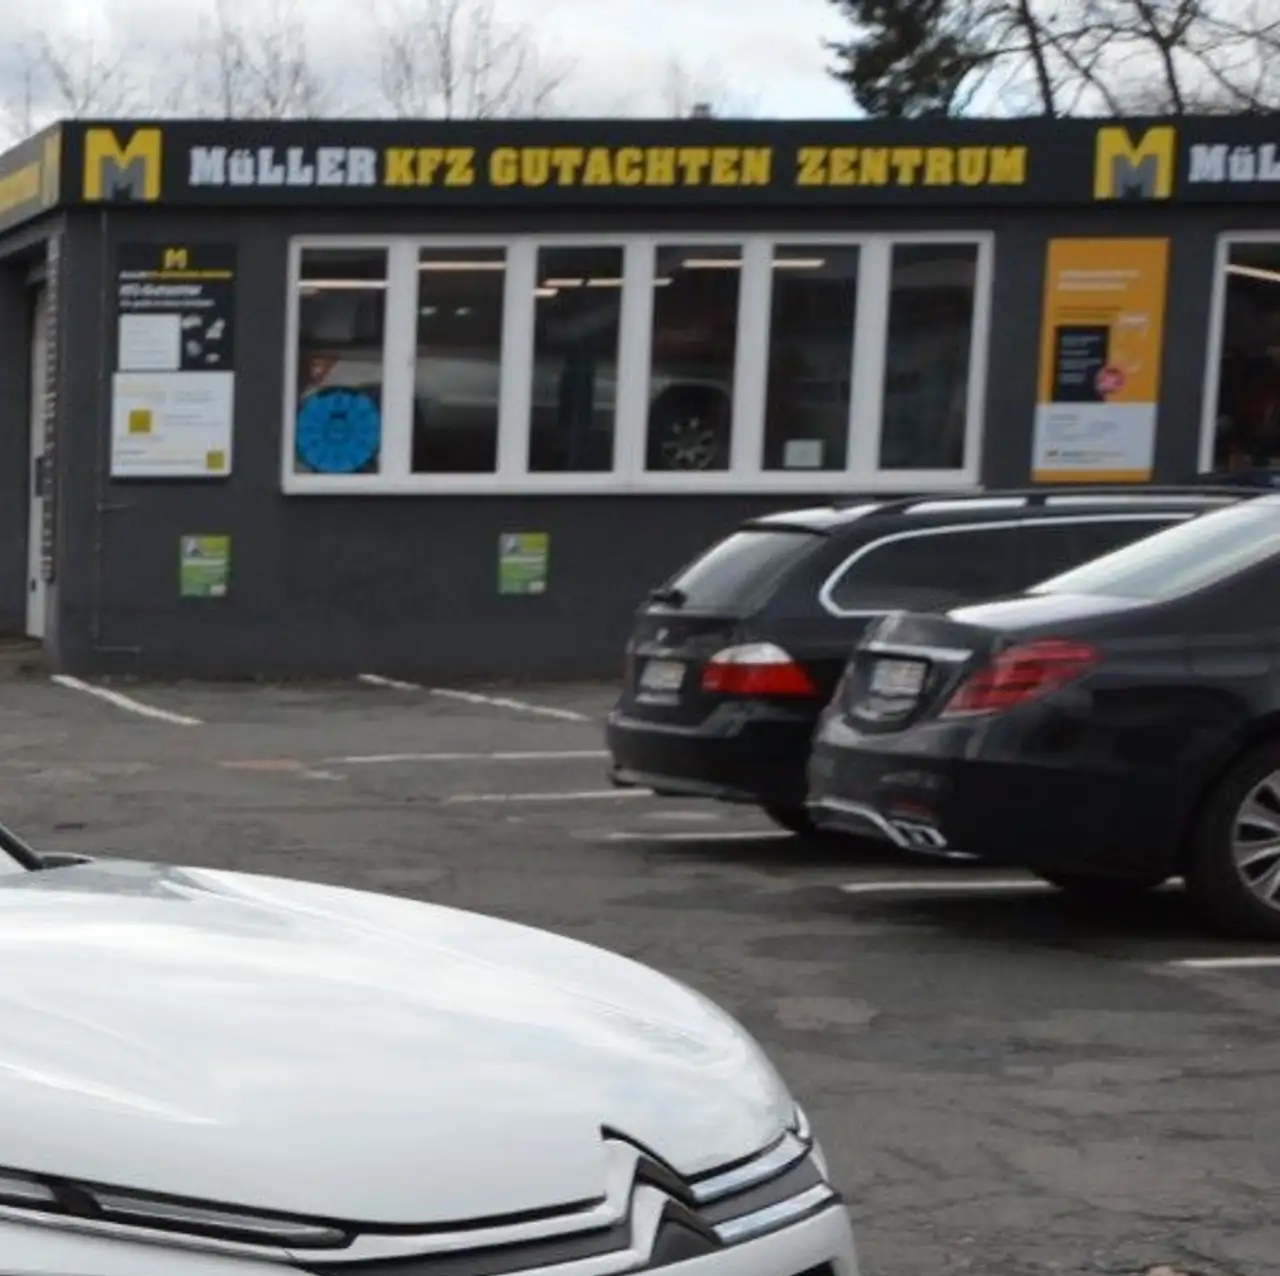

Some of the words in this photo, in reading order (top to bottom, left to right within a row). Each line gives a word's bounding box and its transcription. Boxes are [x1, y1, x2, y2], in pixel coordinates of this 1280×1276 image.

[384, 147, 475, 185] KFZ
[490, 147, 772, 186] GUTACHTEN
[796, 146, 1027, 185] ZENTRUM
